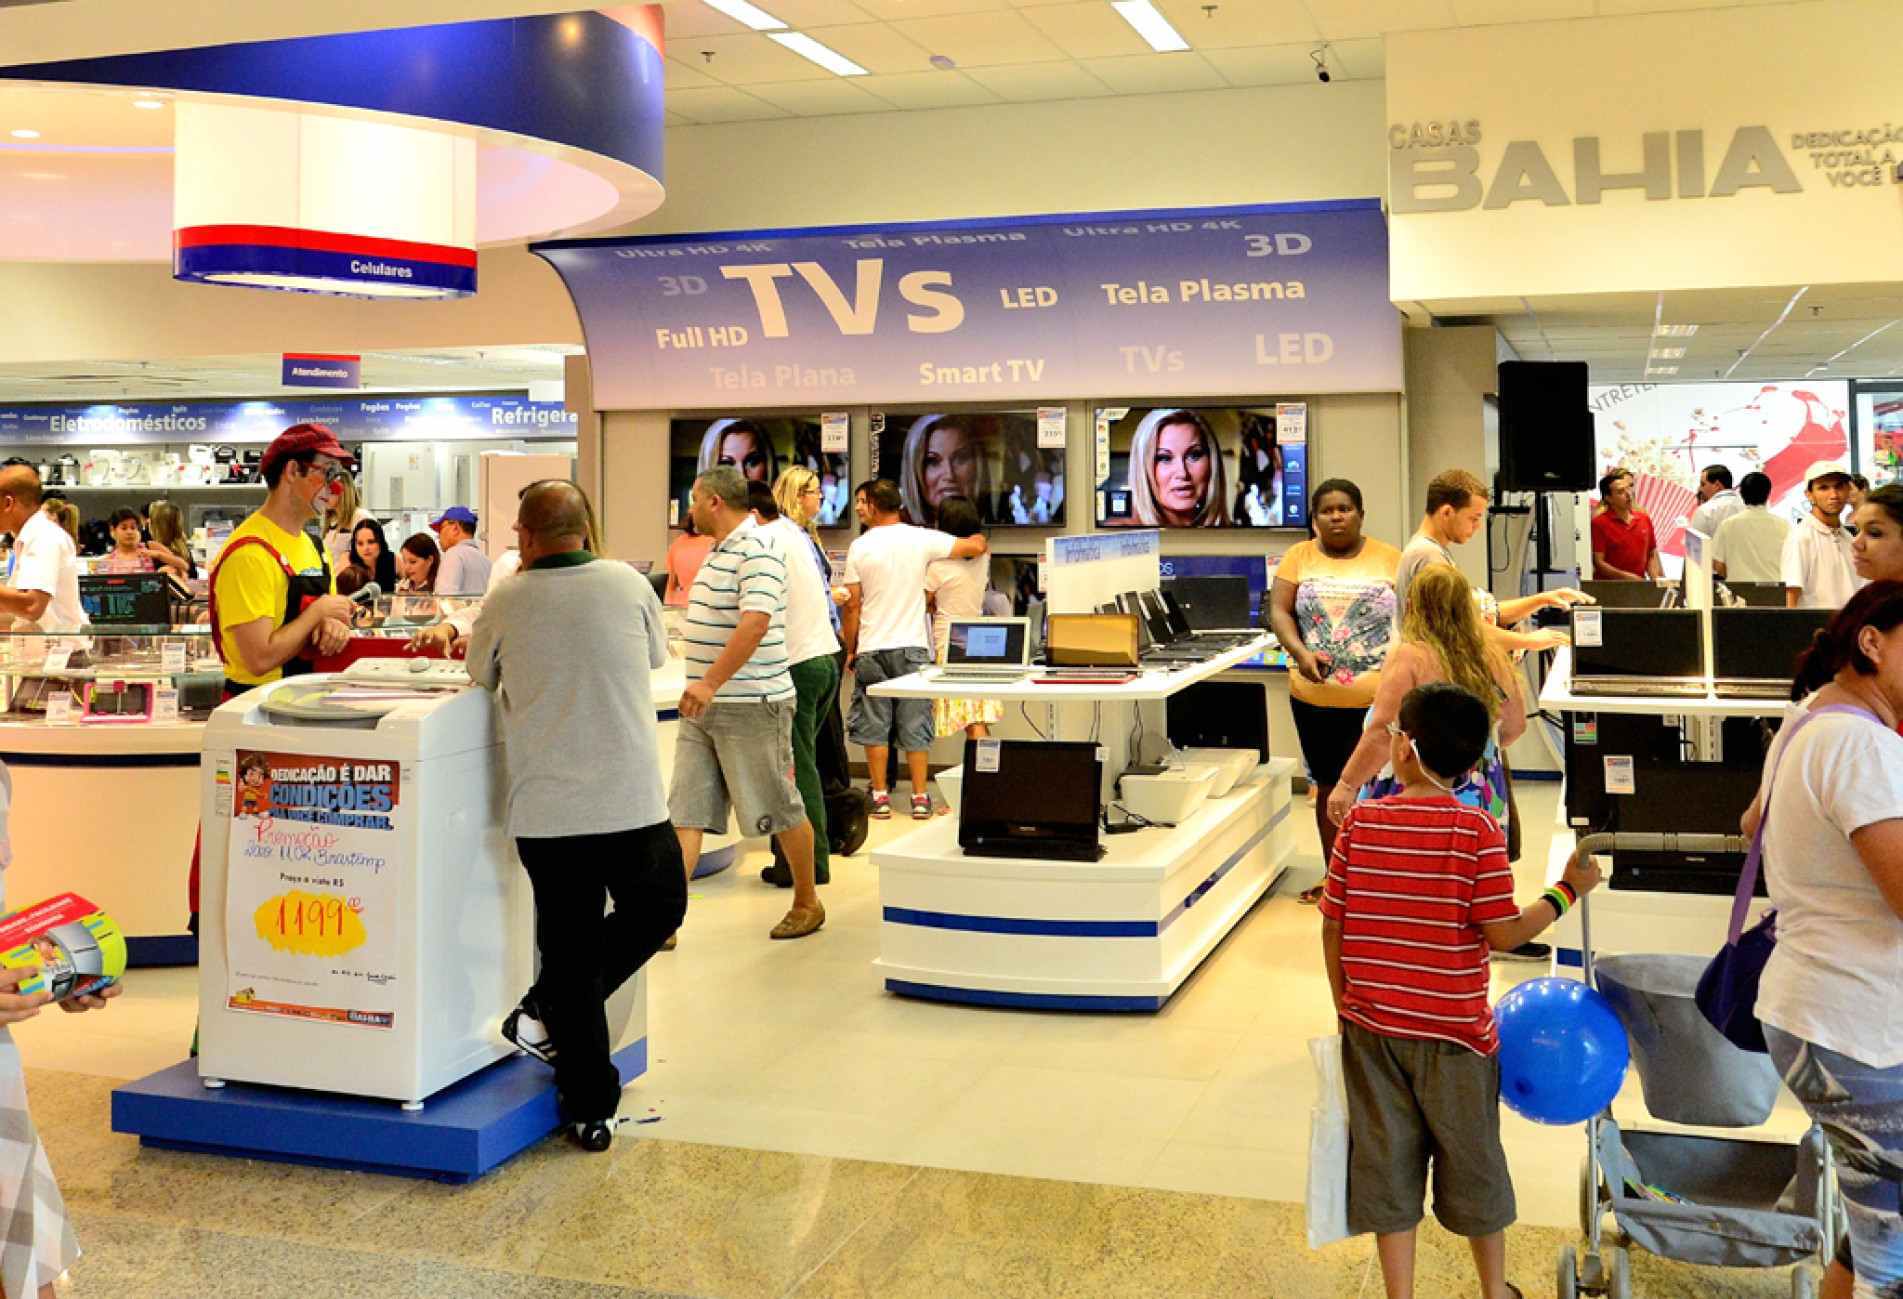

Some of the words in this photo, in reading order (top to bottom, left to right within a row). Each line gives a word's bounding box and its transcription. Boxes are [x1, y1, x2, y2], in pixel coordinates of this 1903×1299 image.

[1388, 120, 1482, 149] CASAS
[1390, 125, 1803, 215] BAHIA
[1809, 150, 1876, 169] TOTAL
[1880, 149, 1897, 165] A
[1826, 166, 1882, 187] VOCÊ
[1063, 226, 1139, 237] Ultra
[1147, 223, 1193, 233] HD
[1201, 220, 1243, 230] 4K
[842, 234, 906, 249] Tela
[911, 232, 1027, 246] Plasma
[1244, 233, 1313, 257] 3D
[351, 260, 413, 278] Celulares
[658, 276, 708, 296] 3D
[1101, 281, 1170, 306] Tela
[1180, 277, 1307, 302] Plasma
[720, 258, 965, 338] TVs
[1000, 287, 1058, 309] LED
[656, 327, 703, 350] Full
[710, 327, 749, 347] HD
[1255, 332, 1335, 366] LED
[1119, 345, 1186, 374] TVs
[710, 366, 762, 389] Tela
[776, 364, 856, 388] Plana
[920, 362, 1001, 385] Smart
[1007, 359, 1045, 382] TV
[51, 413, 207, 433] Eletrodomésticos
[271, 764, 336, 784] DEDICAÇÃO
[355, 765, 391, 782] DAR
[269, 783, 392, 813] CONDIÇÕES
